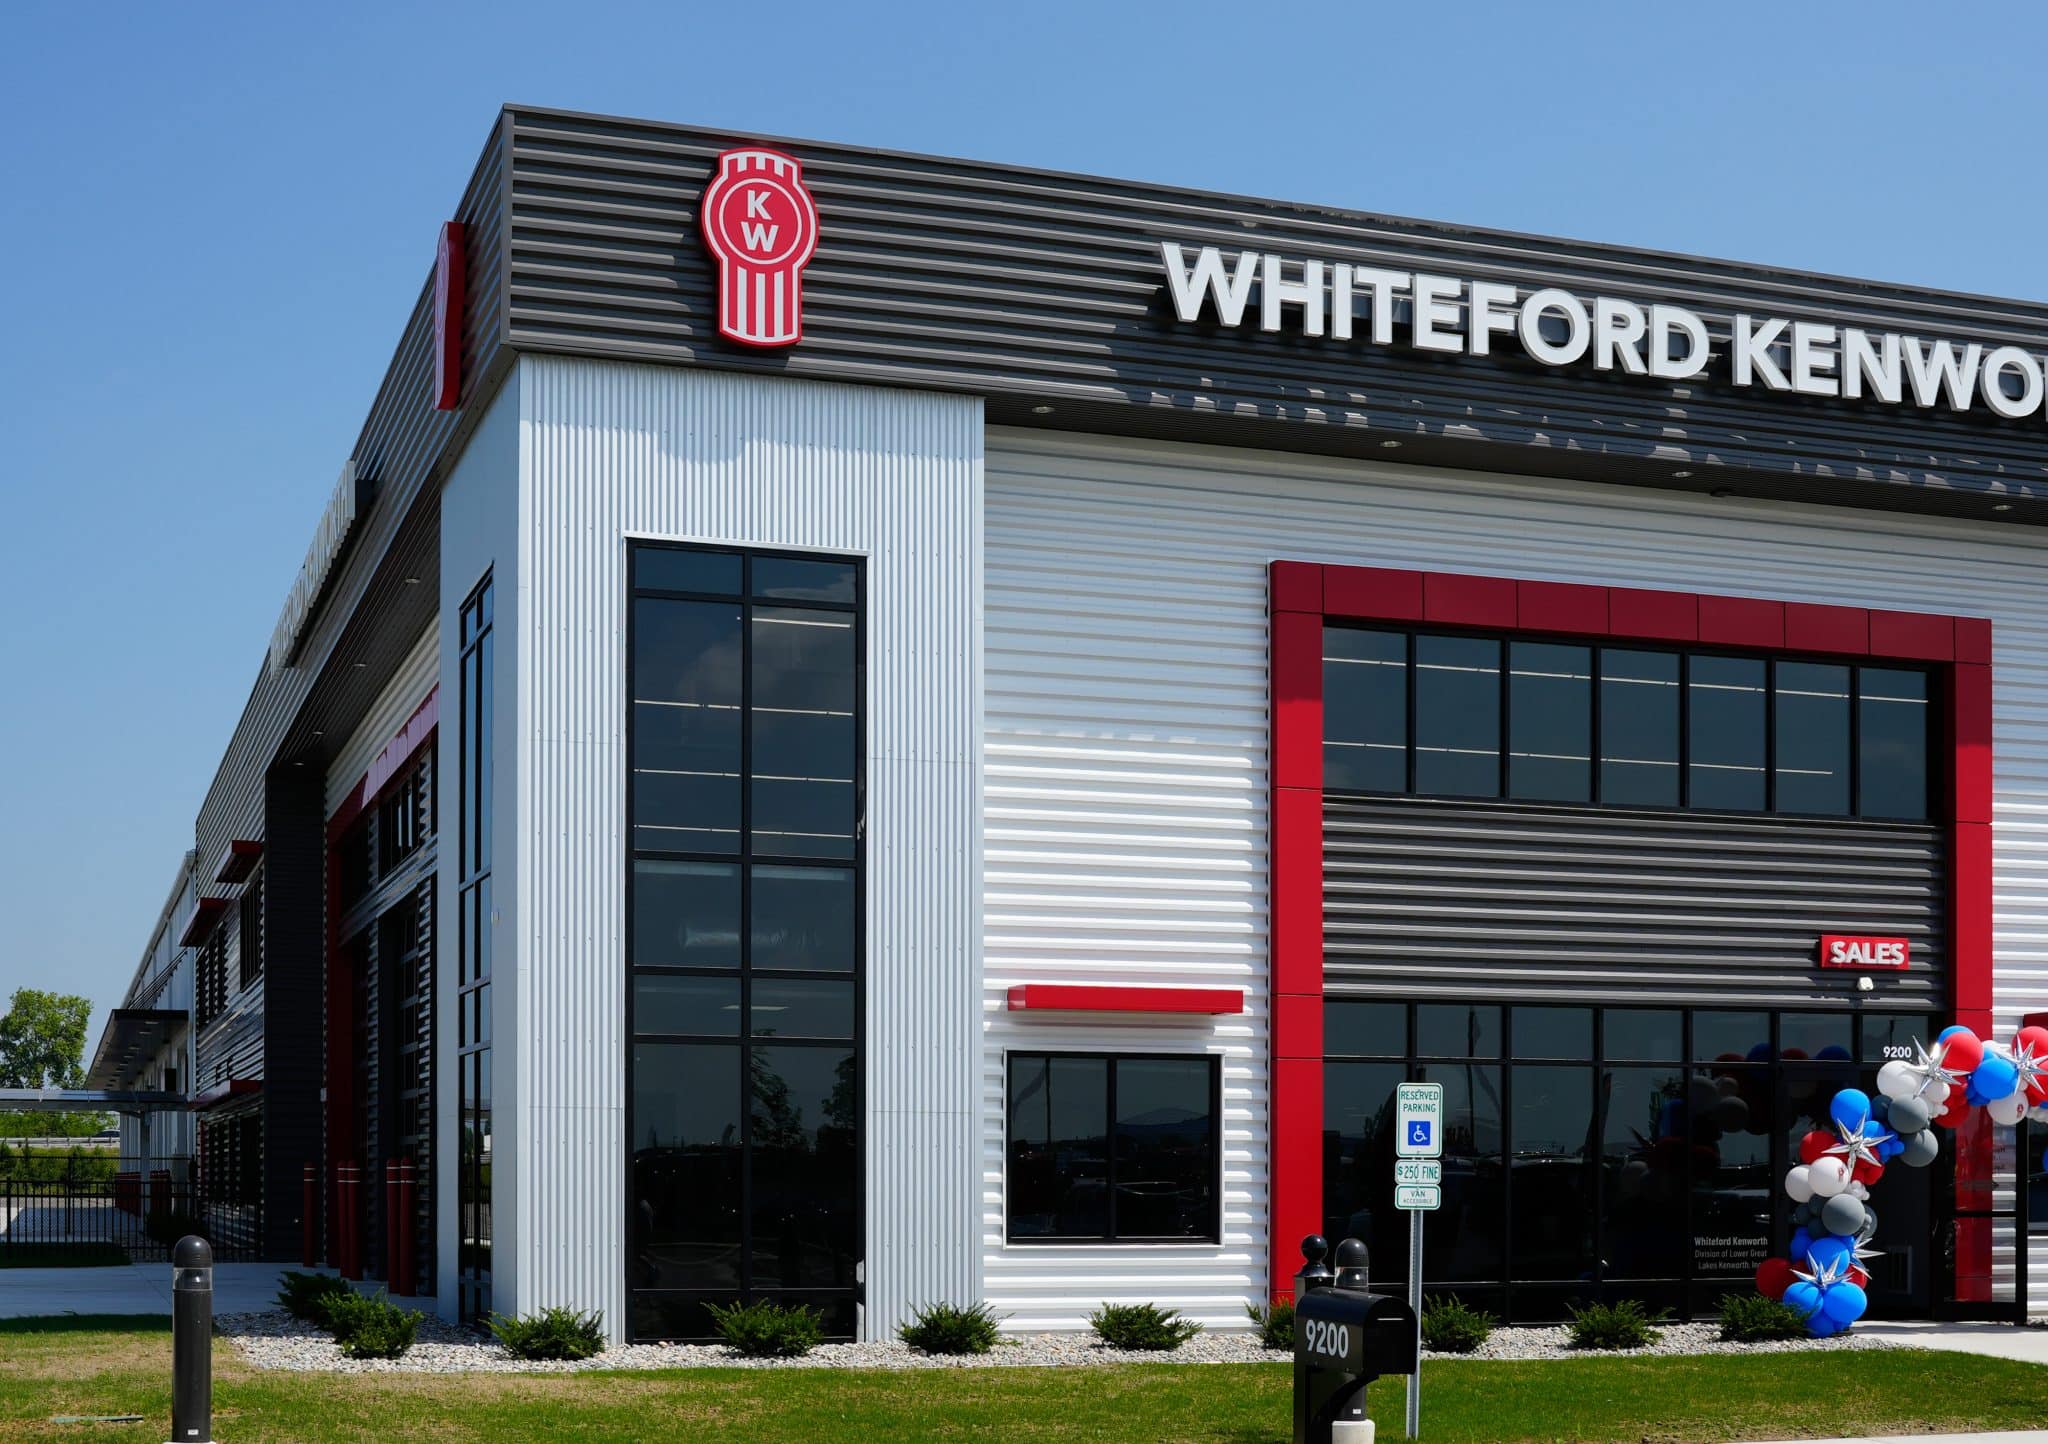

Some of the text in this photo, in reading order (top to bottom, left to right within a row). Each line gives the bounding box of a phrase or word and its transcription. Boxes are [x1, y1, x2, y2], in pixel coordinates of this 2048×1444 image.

[747, 189, 773, 220] K
[740, 221, 779, 252] W
[1161, 241, 2048, 422] WHITEFORD KENWO
[1830, 941, 1905, 965] SALES
[1883, 1046, 1912, 1058] 9200
[1400, 1091, 1439, 1101] RESERVED
[1403, 1103, 1436, 1112] PARKING
[1422, 1166, 1439, 1179] FINE
[1410, 1190, 1426, 1198] VAN
[1694, 1236, 1768, 1246] Whiteford Kenworth
[1694, 1249, 1767, 1258] Division of Lower Great
[1698, 1261, 1718, 1270] Lakes
[1306, 1319, 1349, 1359] 9200
